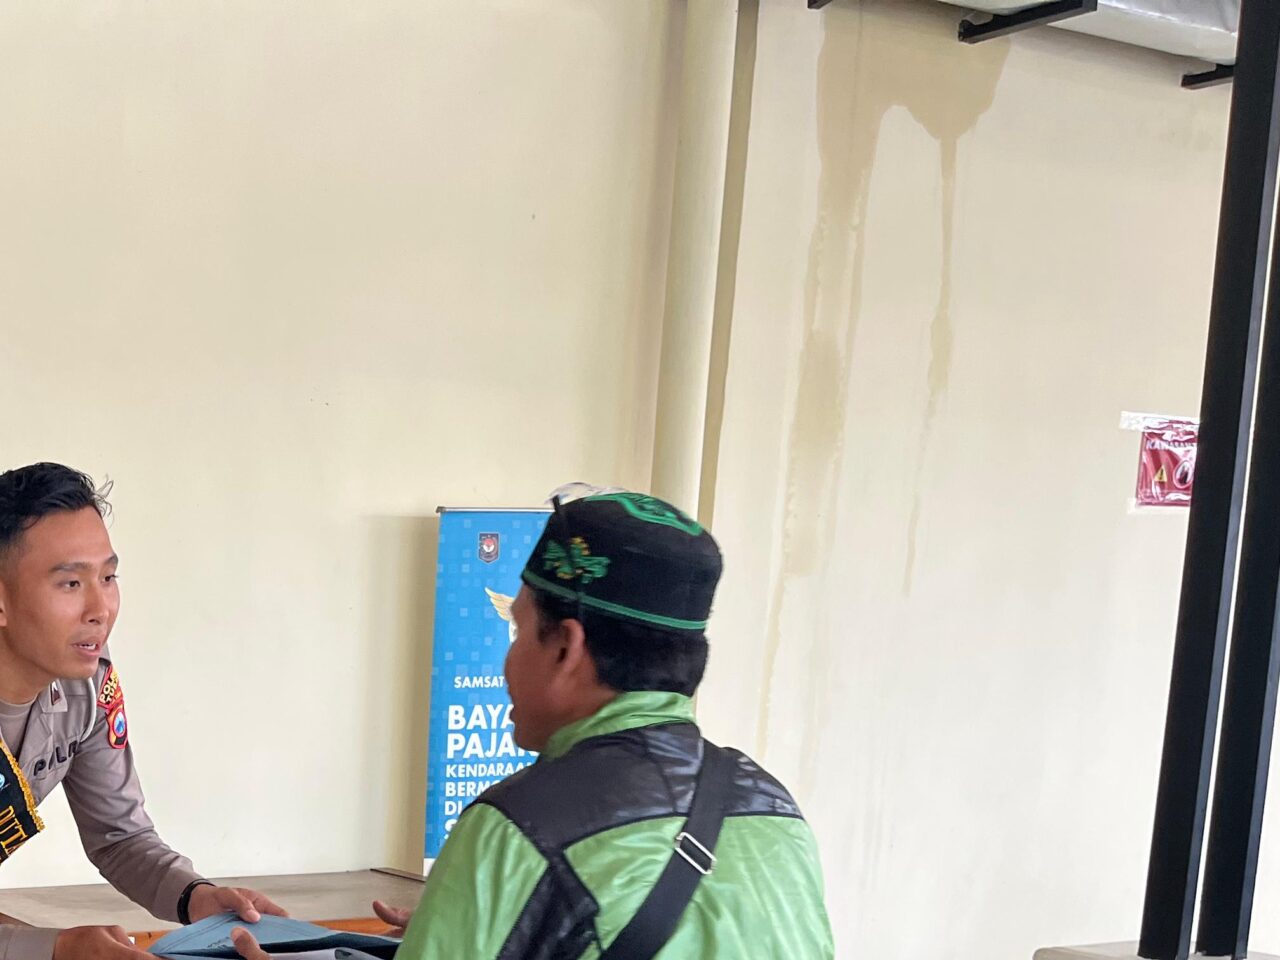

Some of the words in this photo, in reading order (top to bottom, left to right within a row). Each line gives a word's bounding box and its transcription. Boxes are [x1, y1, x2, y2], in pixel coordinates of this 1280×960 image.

[454, 676, 504, 688] SAMSAT
[446, 732, 541, 759] PAJA
[445, 763, 534, 778] KENDARAA
[445, 780, 500, 797] BERM
